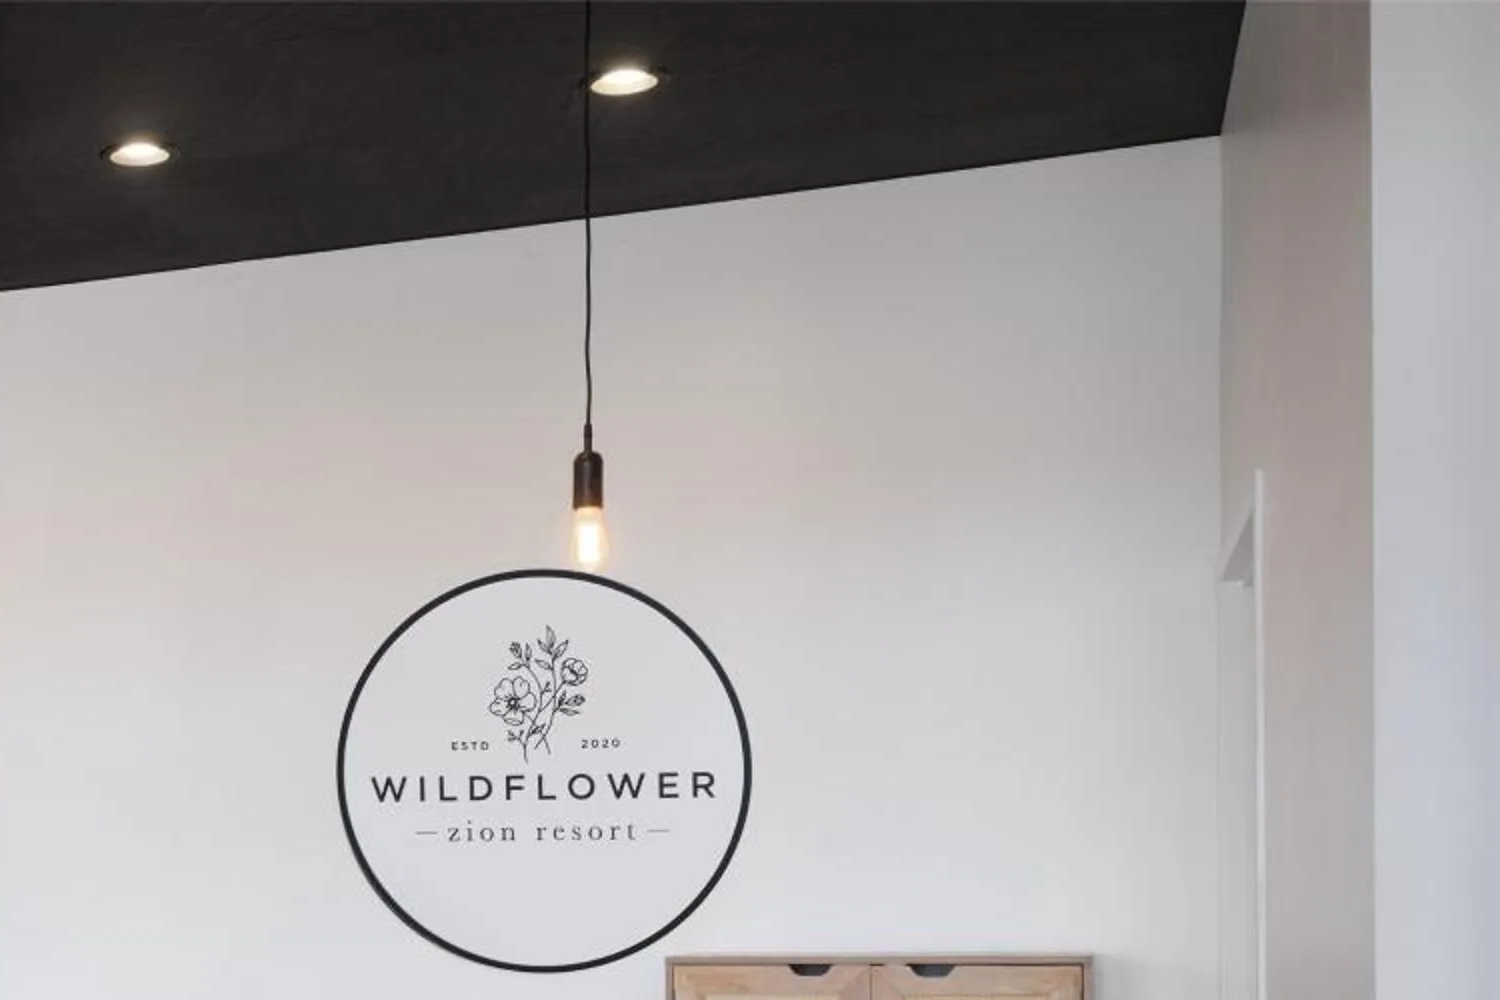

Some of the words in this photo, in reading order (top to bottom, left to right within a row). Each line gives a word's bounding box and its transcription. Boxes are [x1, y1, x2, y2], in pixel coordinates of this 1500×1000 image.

[451, 740, 490, 752] ESTD
[580, 737, 621, 750] 2020
[371, 771, 717, 804] WILDFLOWER
[447, 819, 517, 843] zion
[535, 822, 638, 843] resort
